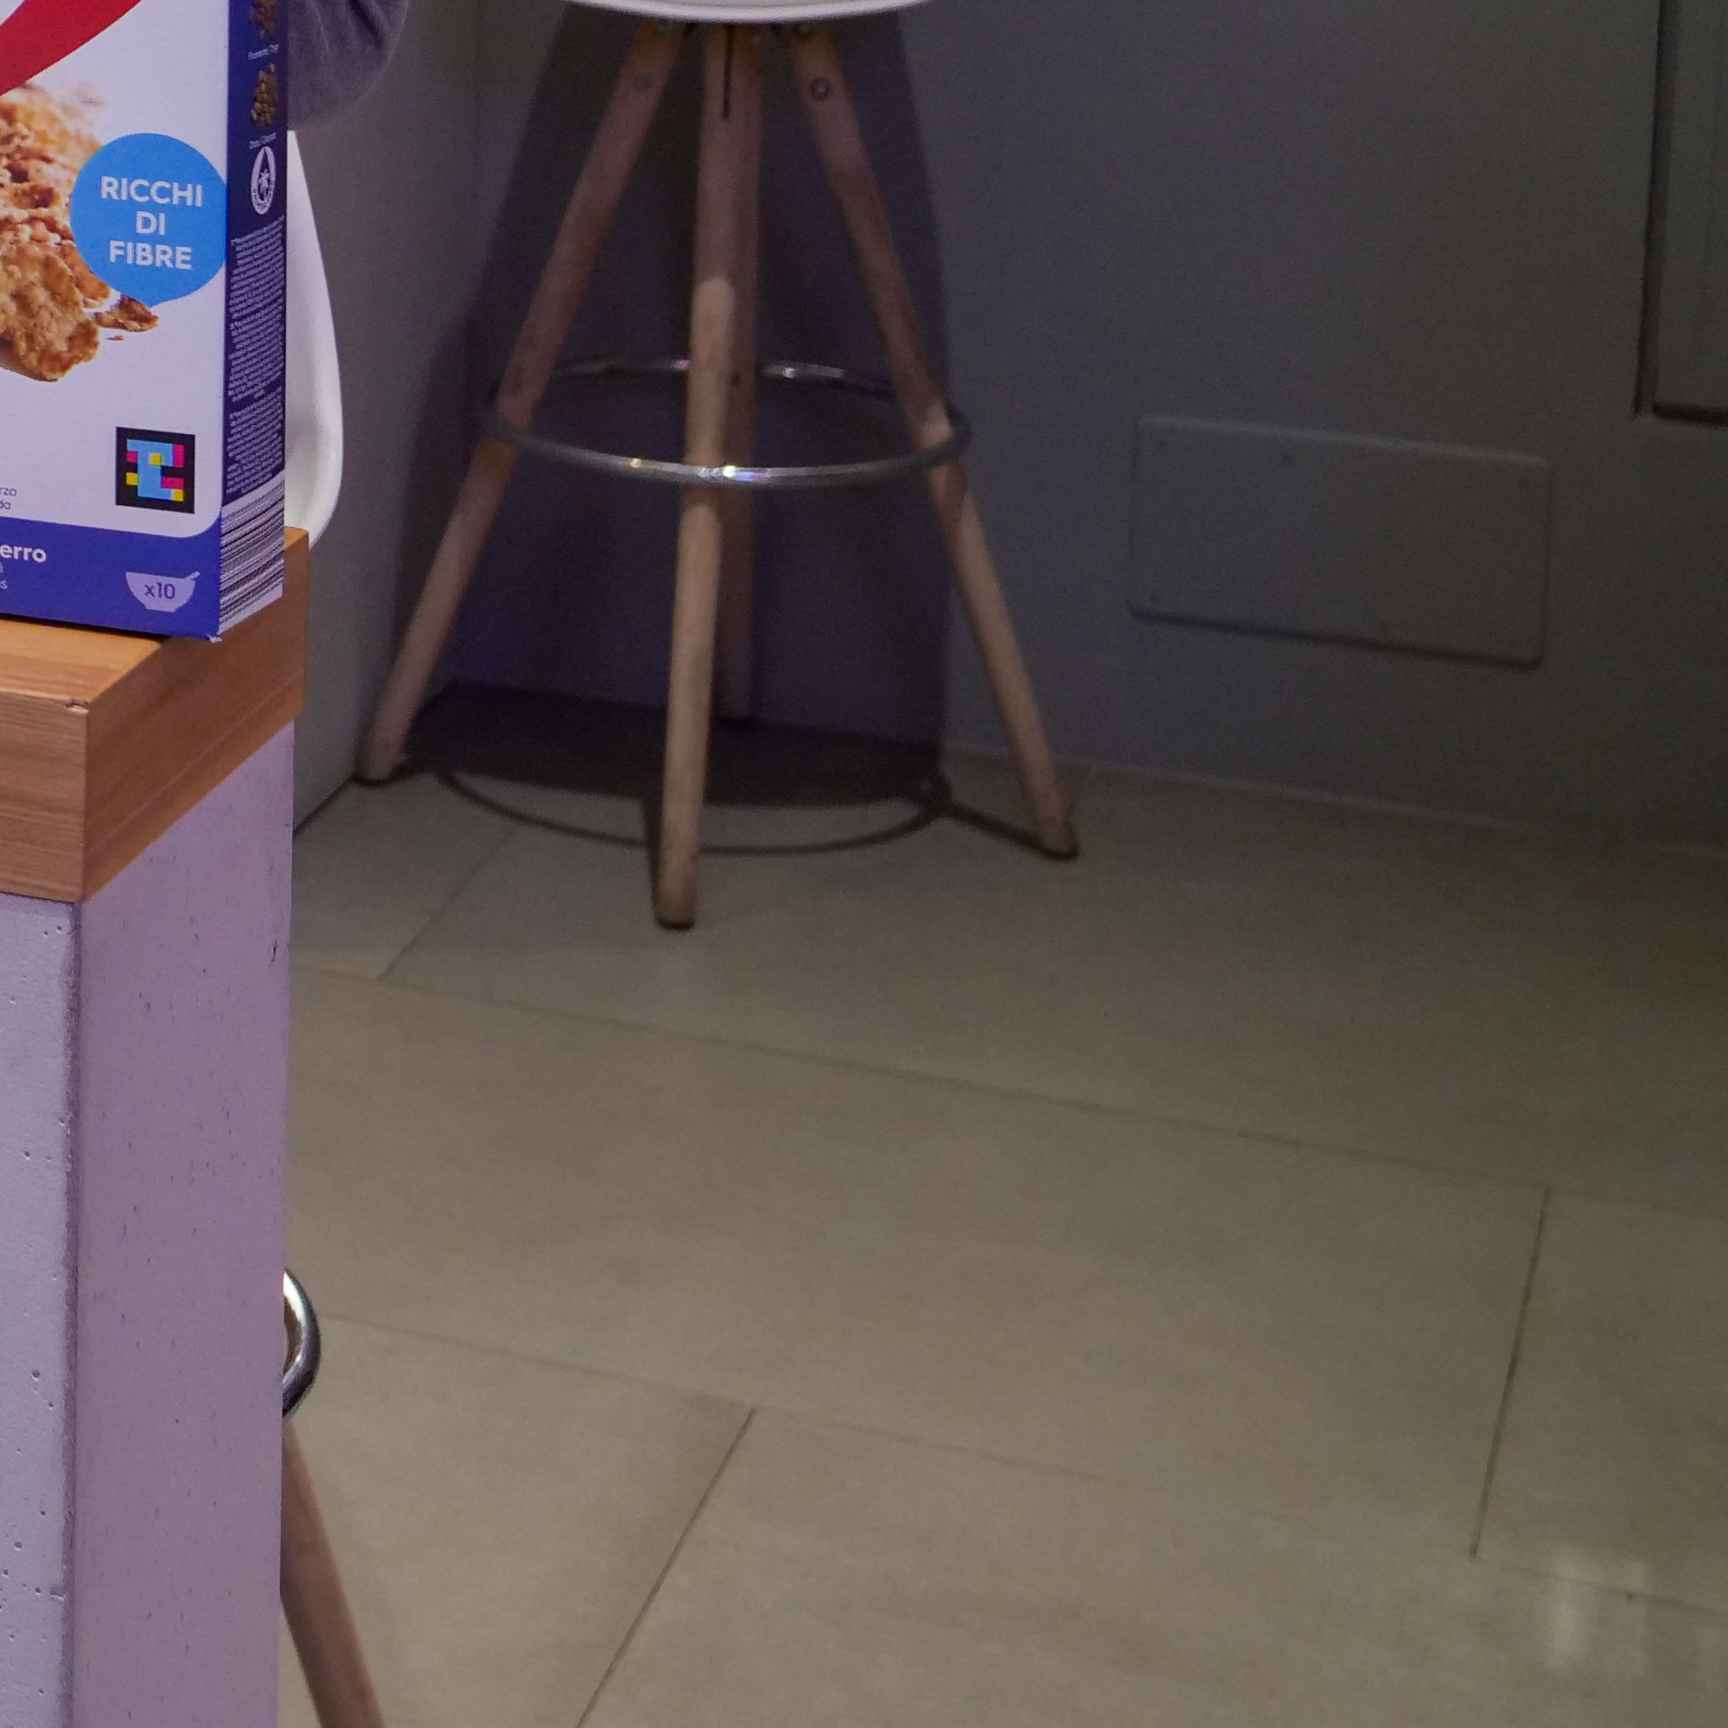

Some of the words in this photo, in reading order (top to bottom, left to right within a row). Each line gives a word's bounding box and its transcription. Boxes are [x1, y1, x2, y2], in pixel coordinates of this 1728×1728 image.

[100, 175, 204, 208] RICCHI
[135, 210, 167, 236] DI
[108, 239, 194, 271] FIBRE
[144, 582, 176, 600] x10
